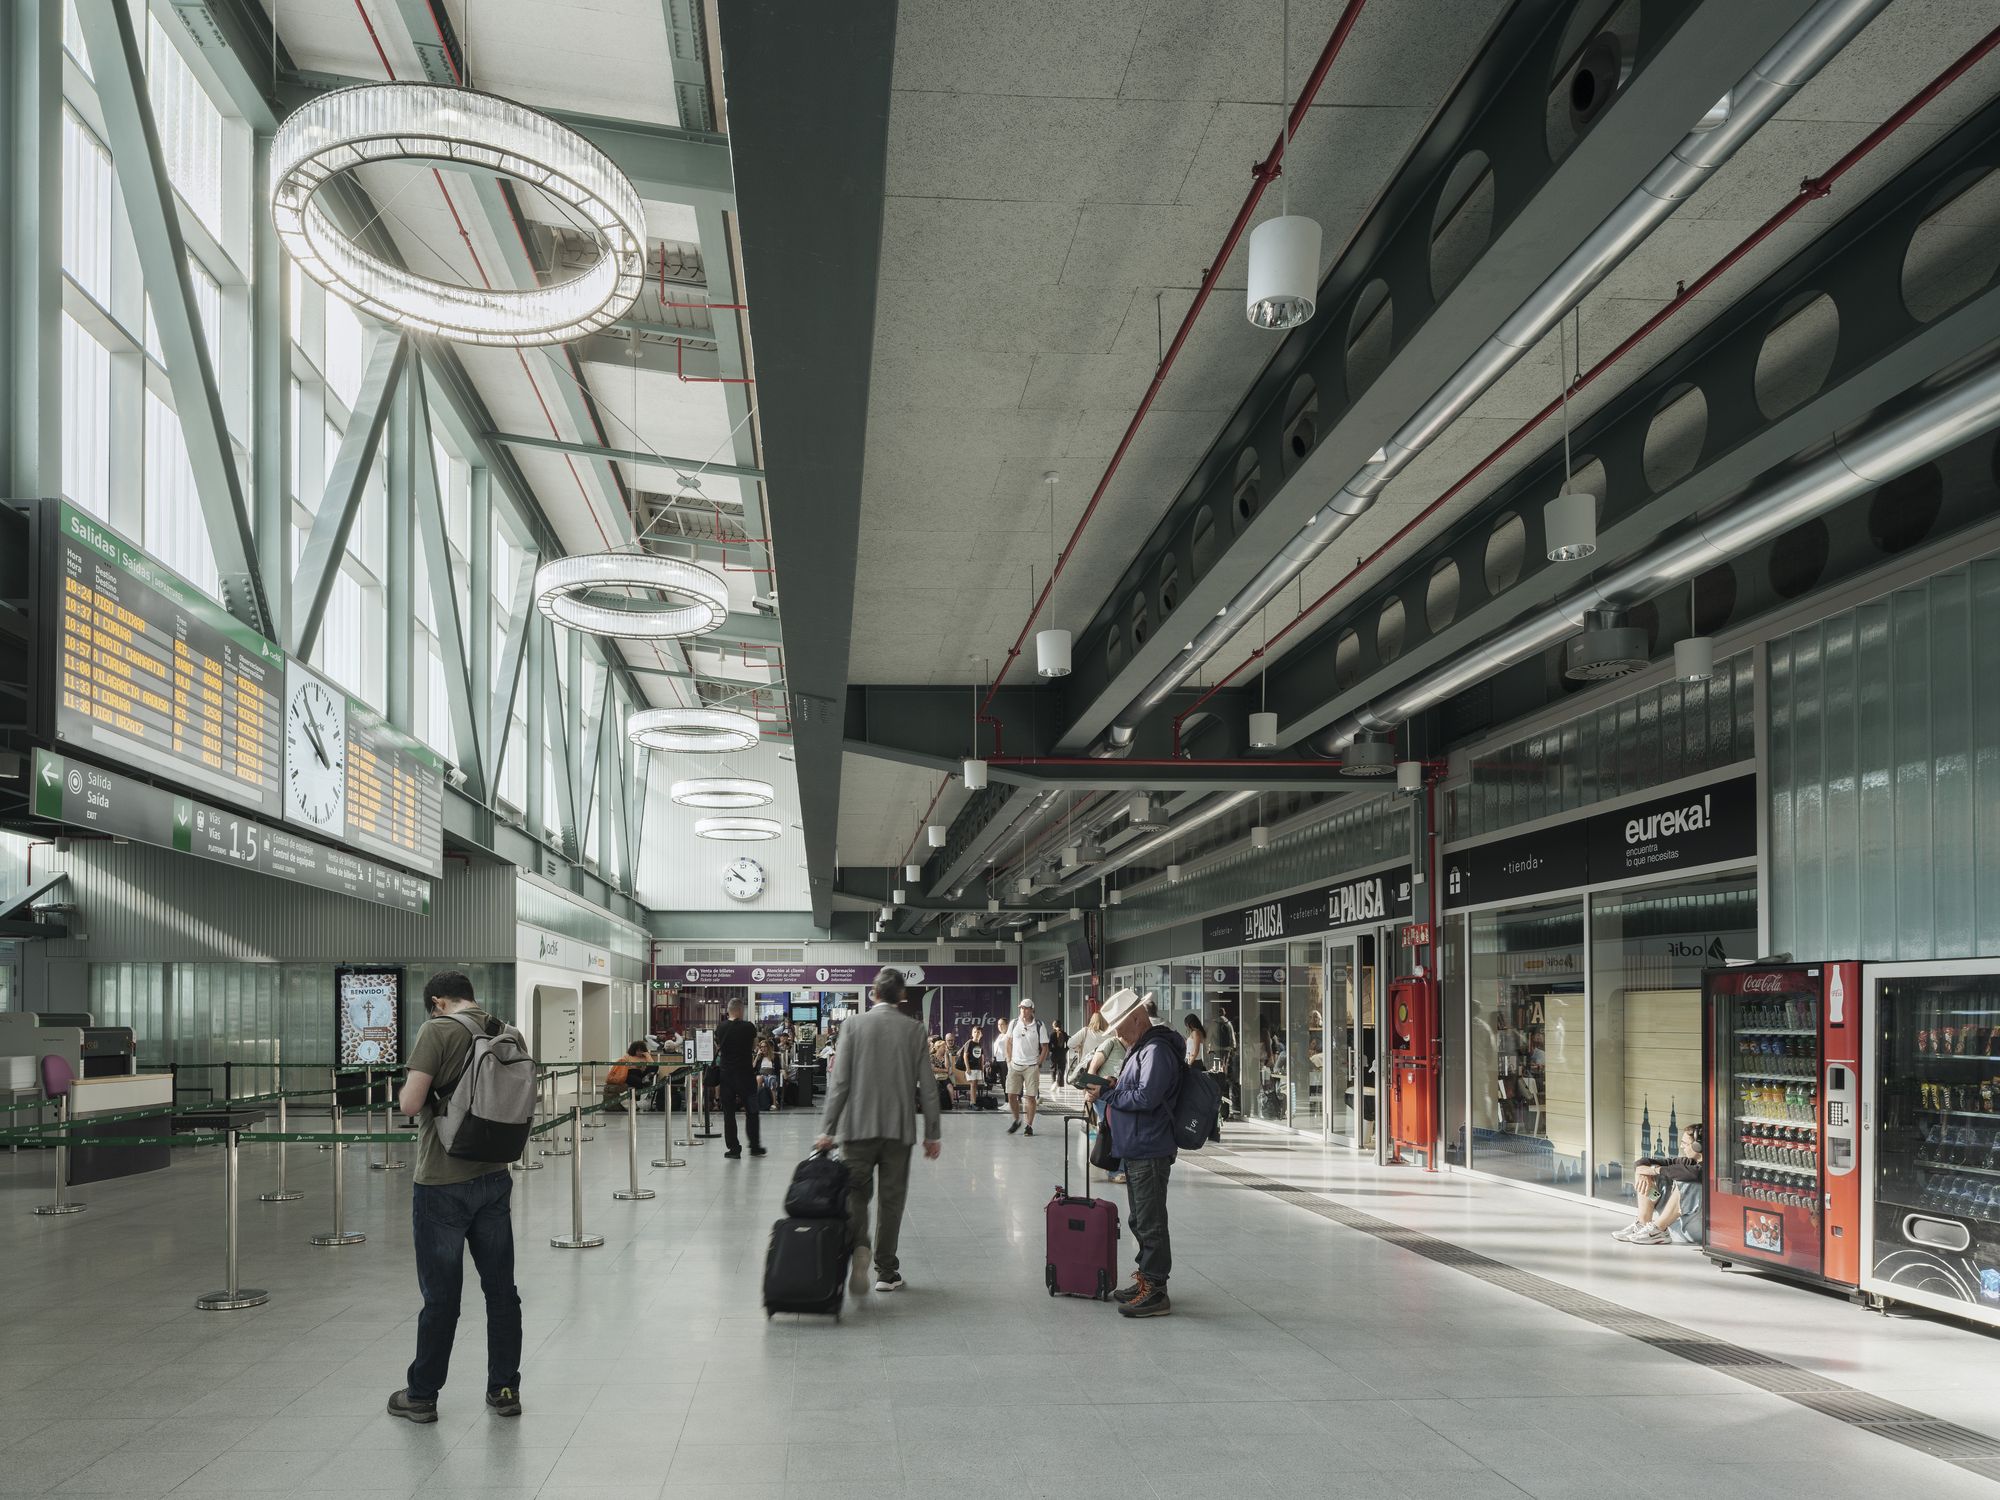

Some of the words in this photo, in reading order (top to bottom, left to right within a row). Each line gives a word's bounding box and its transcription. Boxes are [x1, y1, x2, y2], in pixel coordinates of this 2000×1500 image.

[71, 515, 115, 558] Salidas
[67, 547, 81, 564] Hora
[66, 557, 81, 574] Hora
[95, 564, 116, 585] Destino
[122, 552, 150, 581] Saídas
[95, 574, 116, 594] Destino
[66, 576, 91, 602] 10:24
[94, 592, 113, 615] VIGO
[65, 595, 91, 621] 10:37
[65, 614, 90, 640] 10:49
[64, 634, 90, 658] 10:57
[88, 772, 112, 790] Salida
[87, 791, 109, 808] Saída
[86, 811, 97, 821] EXIT
[209, 812, 221, 825] Vías
[1625, 794, 1711, 844] eureka!
[209, 827, 221, 840] Vías
[230, 822, 240, 859] 1
[241, 850, 246, 860] a
[247, 826, 256, 861] 5
[273, 833, 289, 847] Control
[273, 847, 289, 860] Control
[290, 852, 296, 862] de
[1626, 844, 1658, 857] encuentra
[1626, 858, 1632, 867] lo
[1633, 857, 1646, 867] que
[1647, 849, 1679, 863] necesitas
[1508, 853, 1538, 874] tienda
[1329, 896, 1340, 919] LA
[1340, 878, 1385, 923] PAUSA
[1245, 916, 1252, 935] LA
[1253, 903, 1284, 940] PAUSA
[547, 940, 559, 956] adif
[954, 1012, 996, 1028] renfe
[687, 1048, 692, 1059] B
